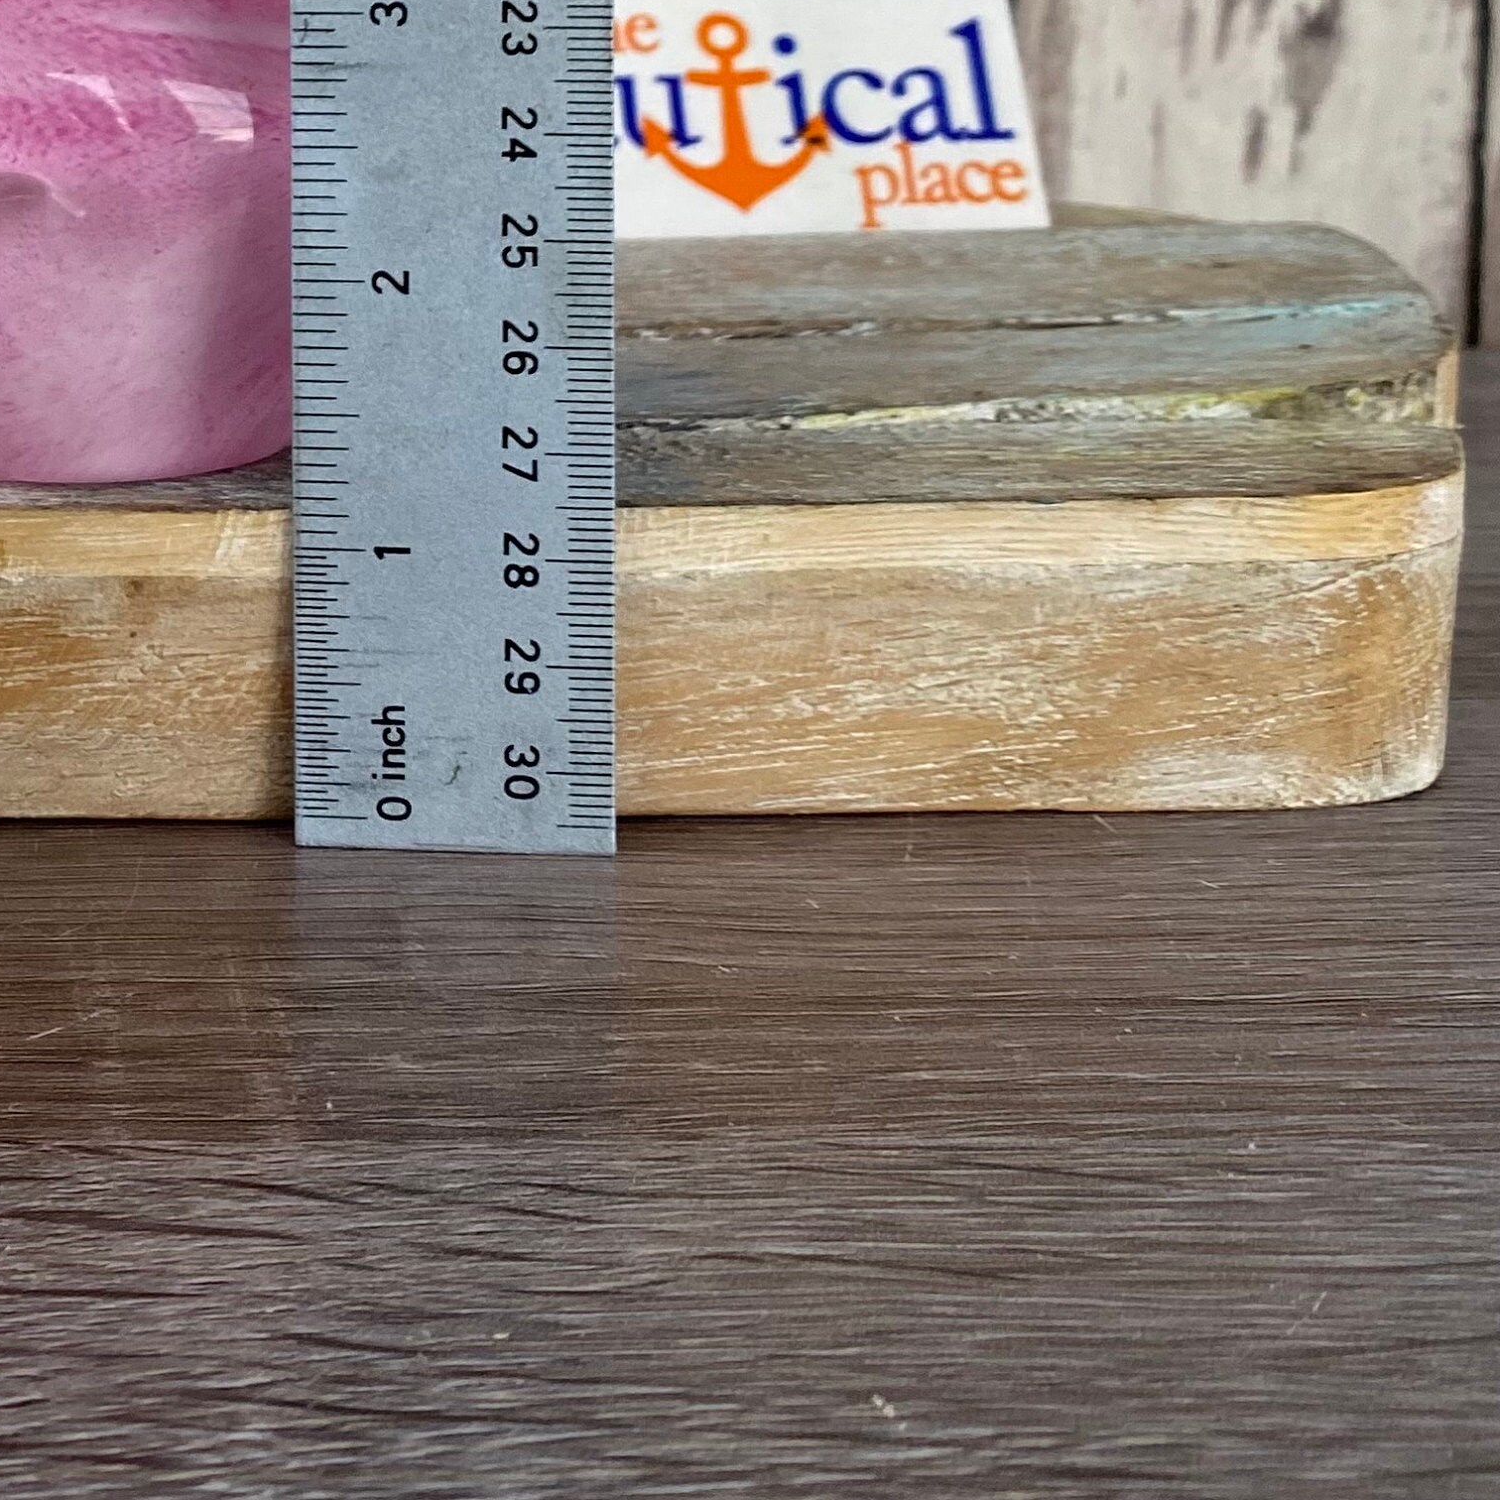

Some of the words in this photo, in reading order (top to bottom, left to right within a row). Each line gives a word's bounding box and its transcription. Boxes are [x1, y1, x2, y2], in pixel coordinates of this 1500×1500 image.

[369, 1, 409, 27] 3
[501, 1, 538, 56] 23
[501, 107, 538, 162] 24
[854, 141, 1028, 229] place
[501, 214, 538, 268] 25
[371, 270, 410, 295] 2
[502, 320, 539, 375] 26
[502, 426, 538, 482] 27
[373, 546, 411, 560] 1
[503, 532, 540, 589] 28
[504, 639, 541, 695] 29
[371, 705, 407, 781] inch
[504, 744, 540, 800] 30
